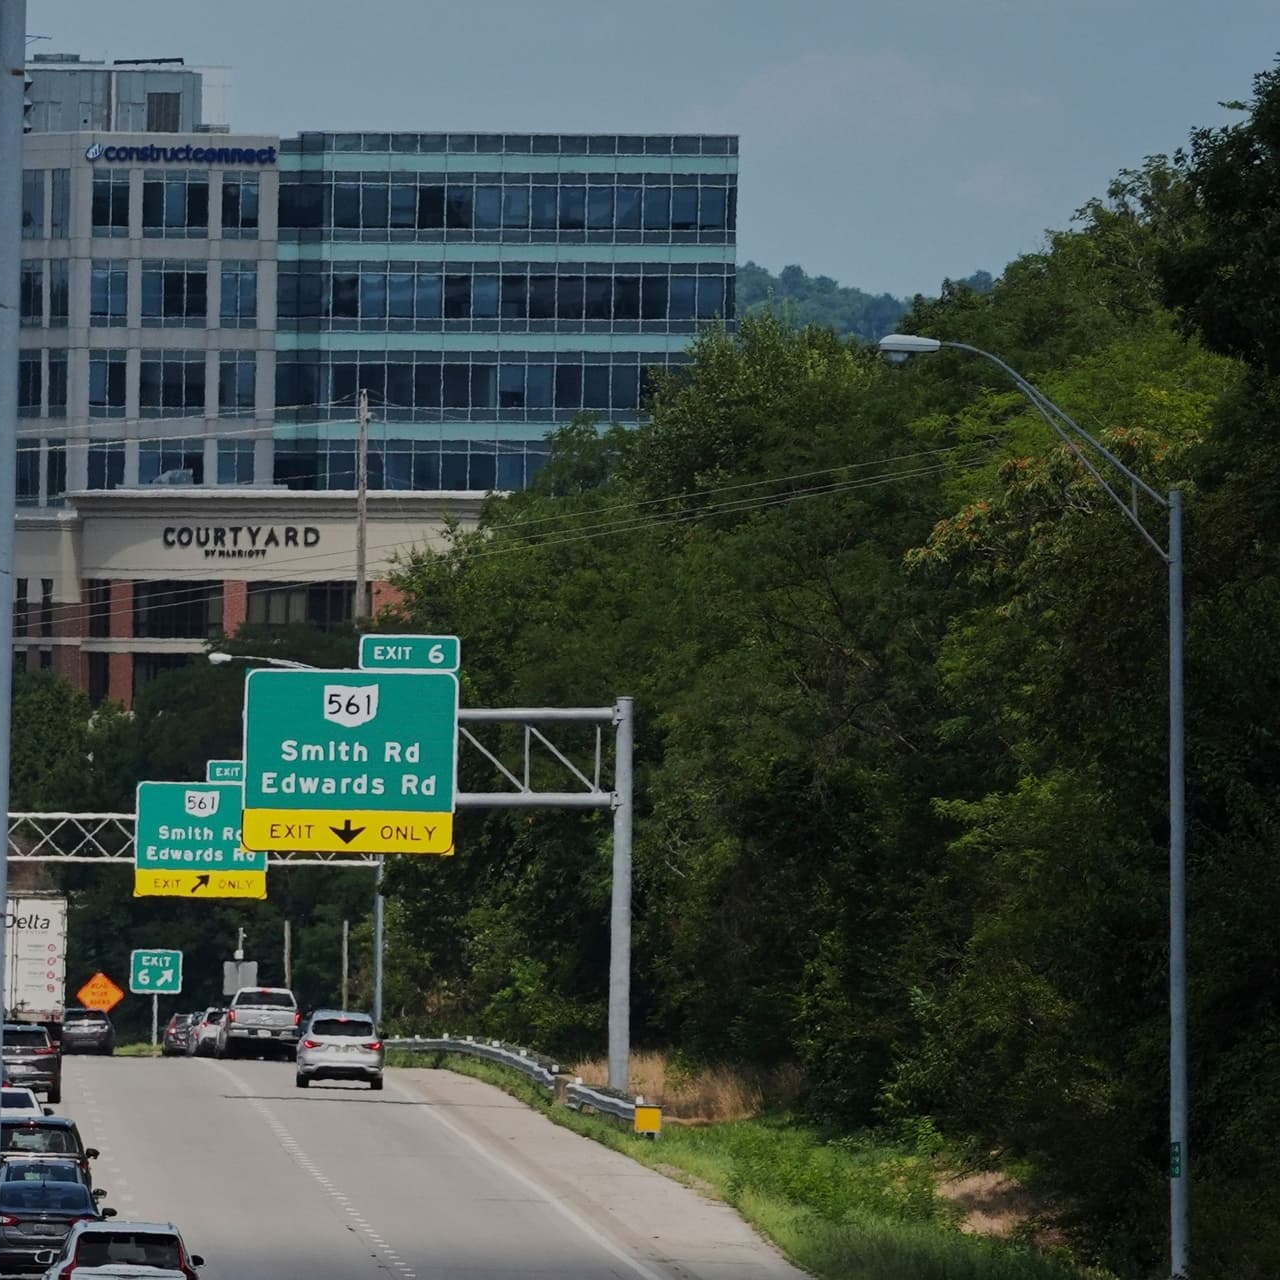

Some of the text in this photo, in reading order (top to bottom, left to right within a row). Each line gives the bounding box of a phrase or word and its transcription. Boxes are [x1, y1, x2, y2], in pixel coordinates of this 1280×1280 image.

[104, 144, 276, 164] constructconnect
[163, 527, 320, 547] COURTYARD
[373, 644, 445, 664] EXIT 6
[328, 694, 371, 715] 561
[281, 740, 420, 763] Smith Rd
[215, 767, 241, 777] EXIT
[261, 772, 436, 796] Edwards Rd
[186, 795, 216, 810] 561
[159, 825, 214, 840] Smith
[270, 823, 437, 841] EXIT ONLY
[146, 846, 224, 861] Edwards
[153, 879, 254, 889] EXIT ONLY
[6, 914, 51, 930] Delta
[142, 956, 172, 967] EXIT
[138, 968, 150, 985] 6
